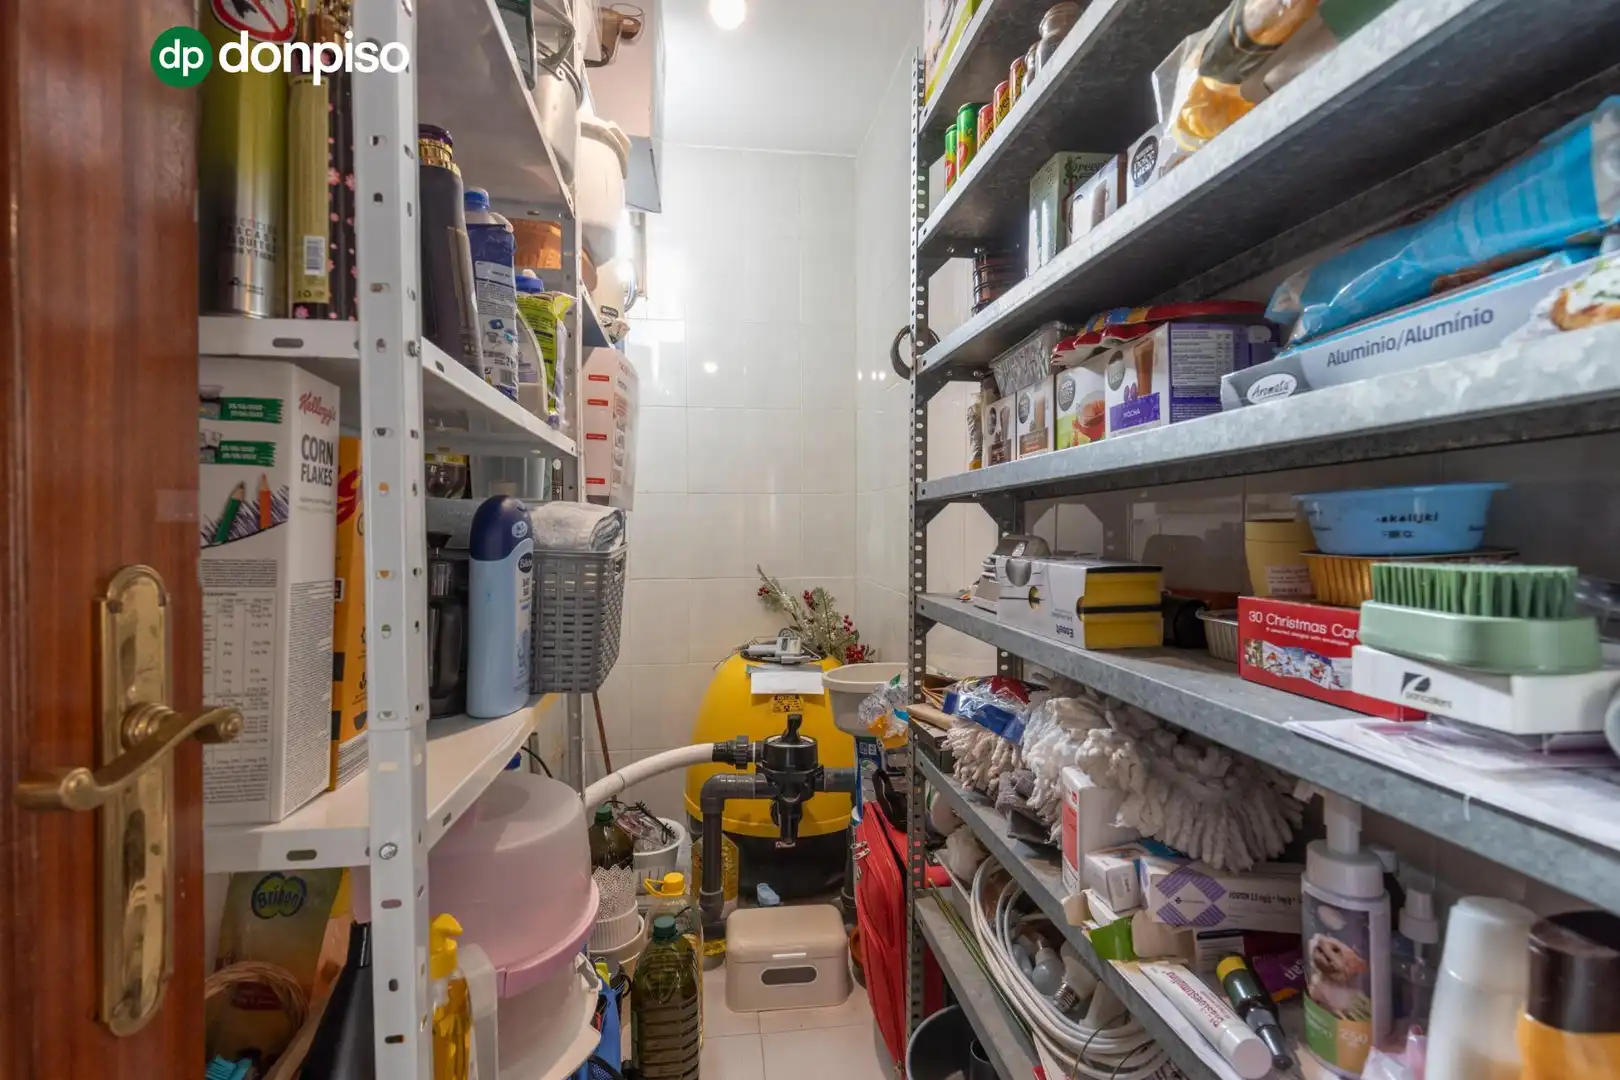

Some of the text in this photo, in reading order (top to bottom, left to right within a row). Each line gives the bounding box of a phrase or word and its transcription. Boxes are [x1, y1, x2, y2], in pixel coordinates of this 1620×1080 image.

[1326, 304, 1495, 368] Aluminio/Alumínio
[298, 388, 336, 426] Kellogg's
[1123, 407, 1142, 419] MOCHA
[301, 433, 334, 466] CORN
[300, 463, 333, 487] FLAKES
[1248, 610, 1263, 624] 30
[1265, 613, 1328, 635] Christmas
[1322, 637, 1350, 646] envelopes
